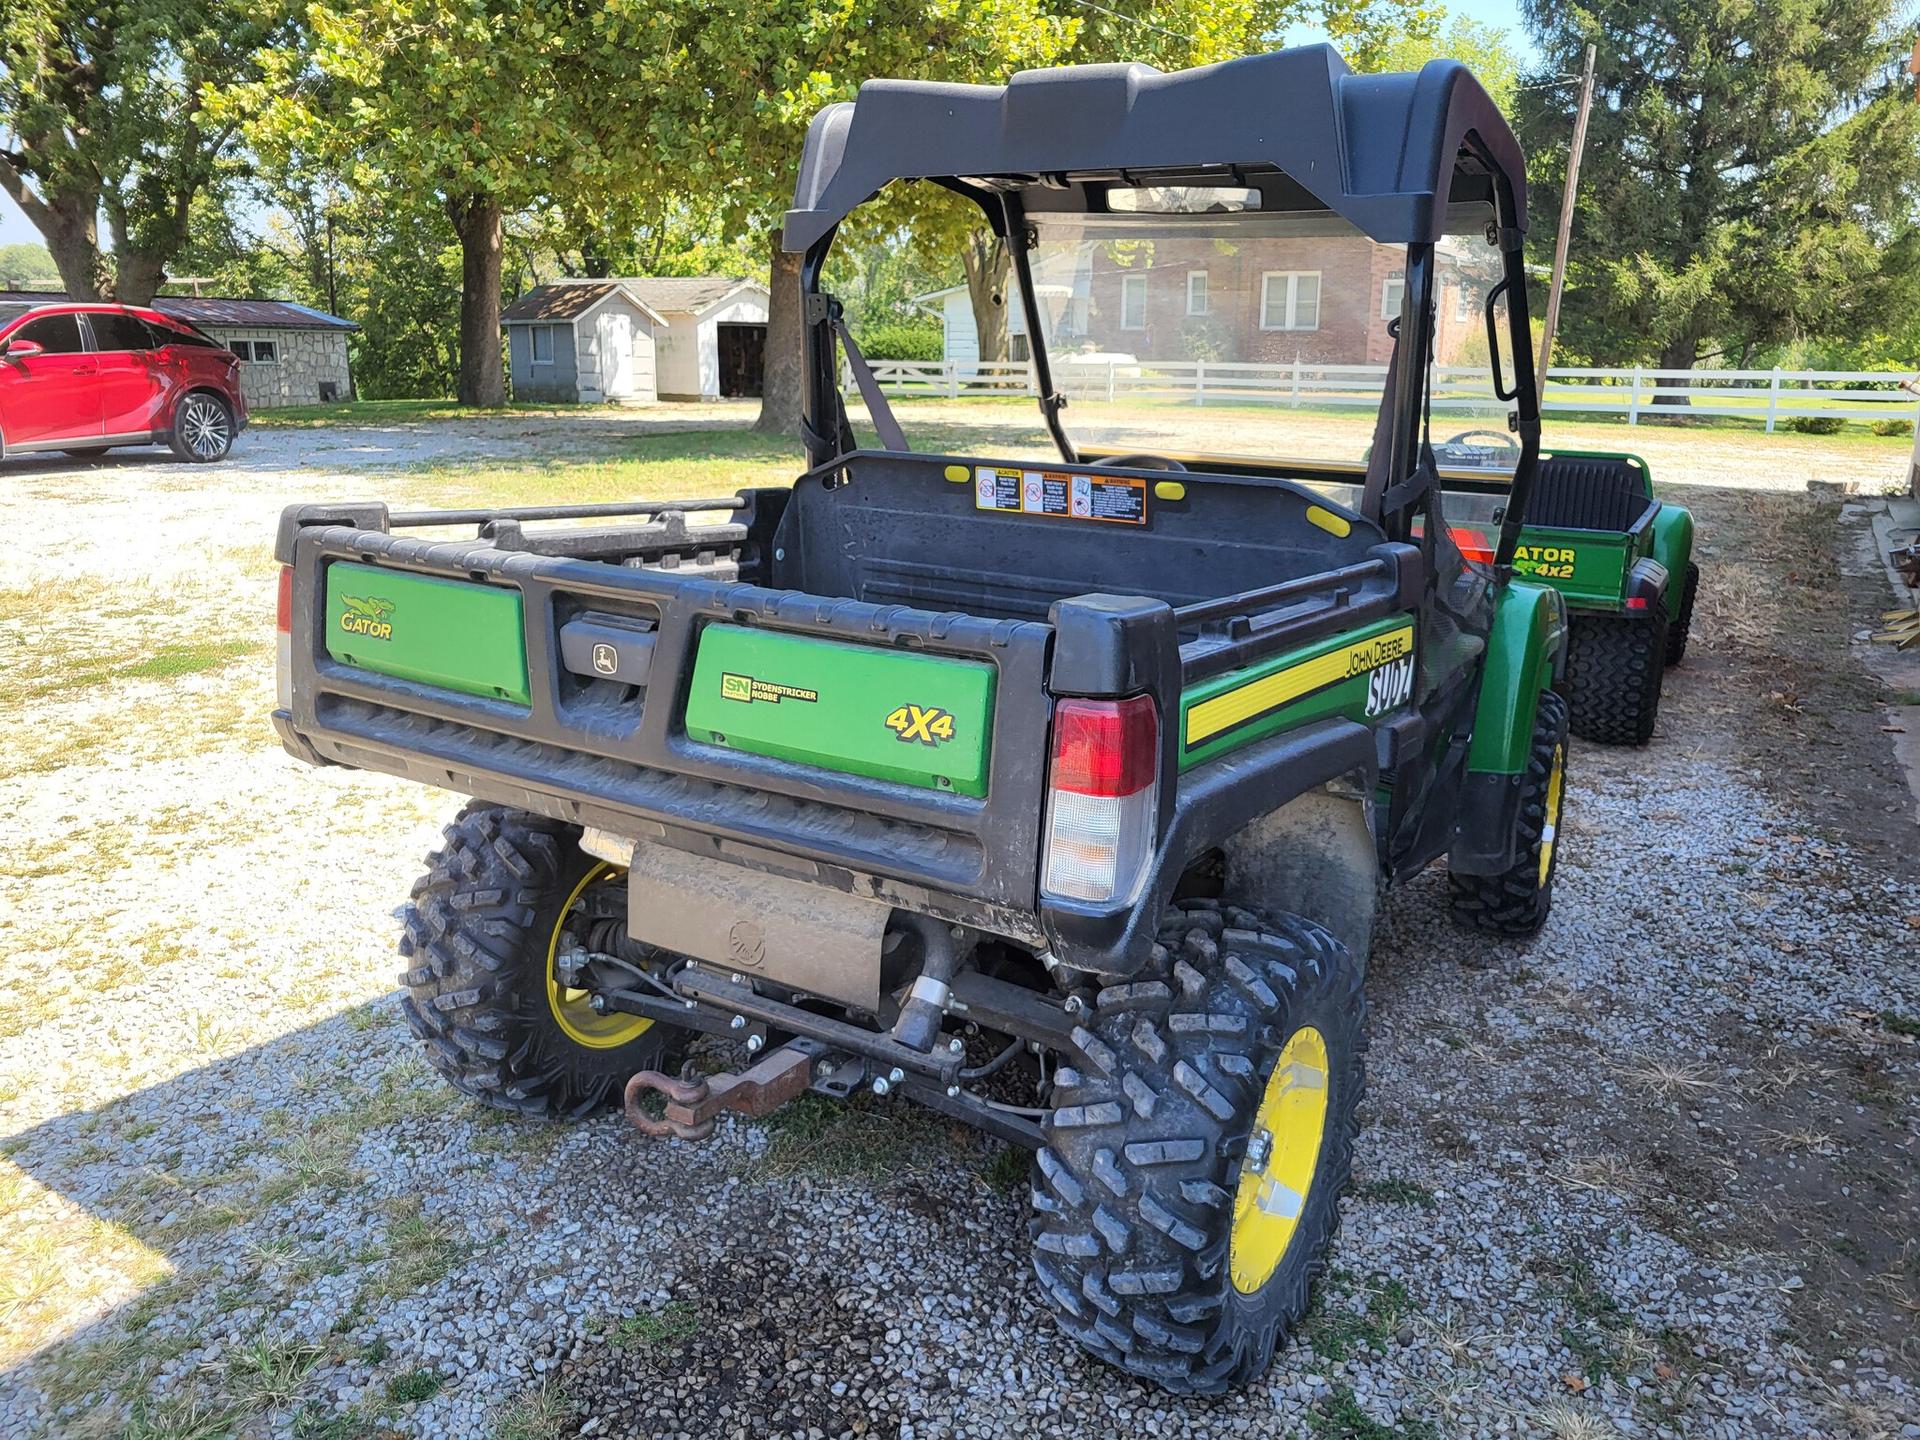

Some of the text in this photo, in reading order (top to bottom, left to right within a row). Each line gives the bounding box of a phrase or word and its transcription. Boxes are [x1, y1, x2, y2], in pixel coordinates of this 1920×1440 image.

[1512, 546, 1576, 563] ATOR
[340, 611, 393, 641] GATOR
[1346, 637, 1404, 675] JOHN DEERE
[724, 677, 749, 694] SN
[752, 681, 817, 701] SYDENSTRICKER
[751, 690, 779, 702] NOBBE
